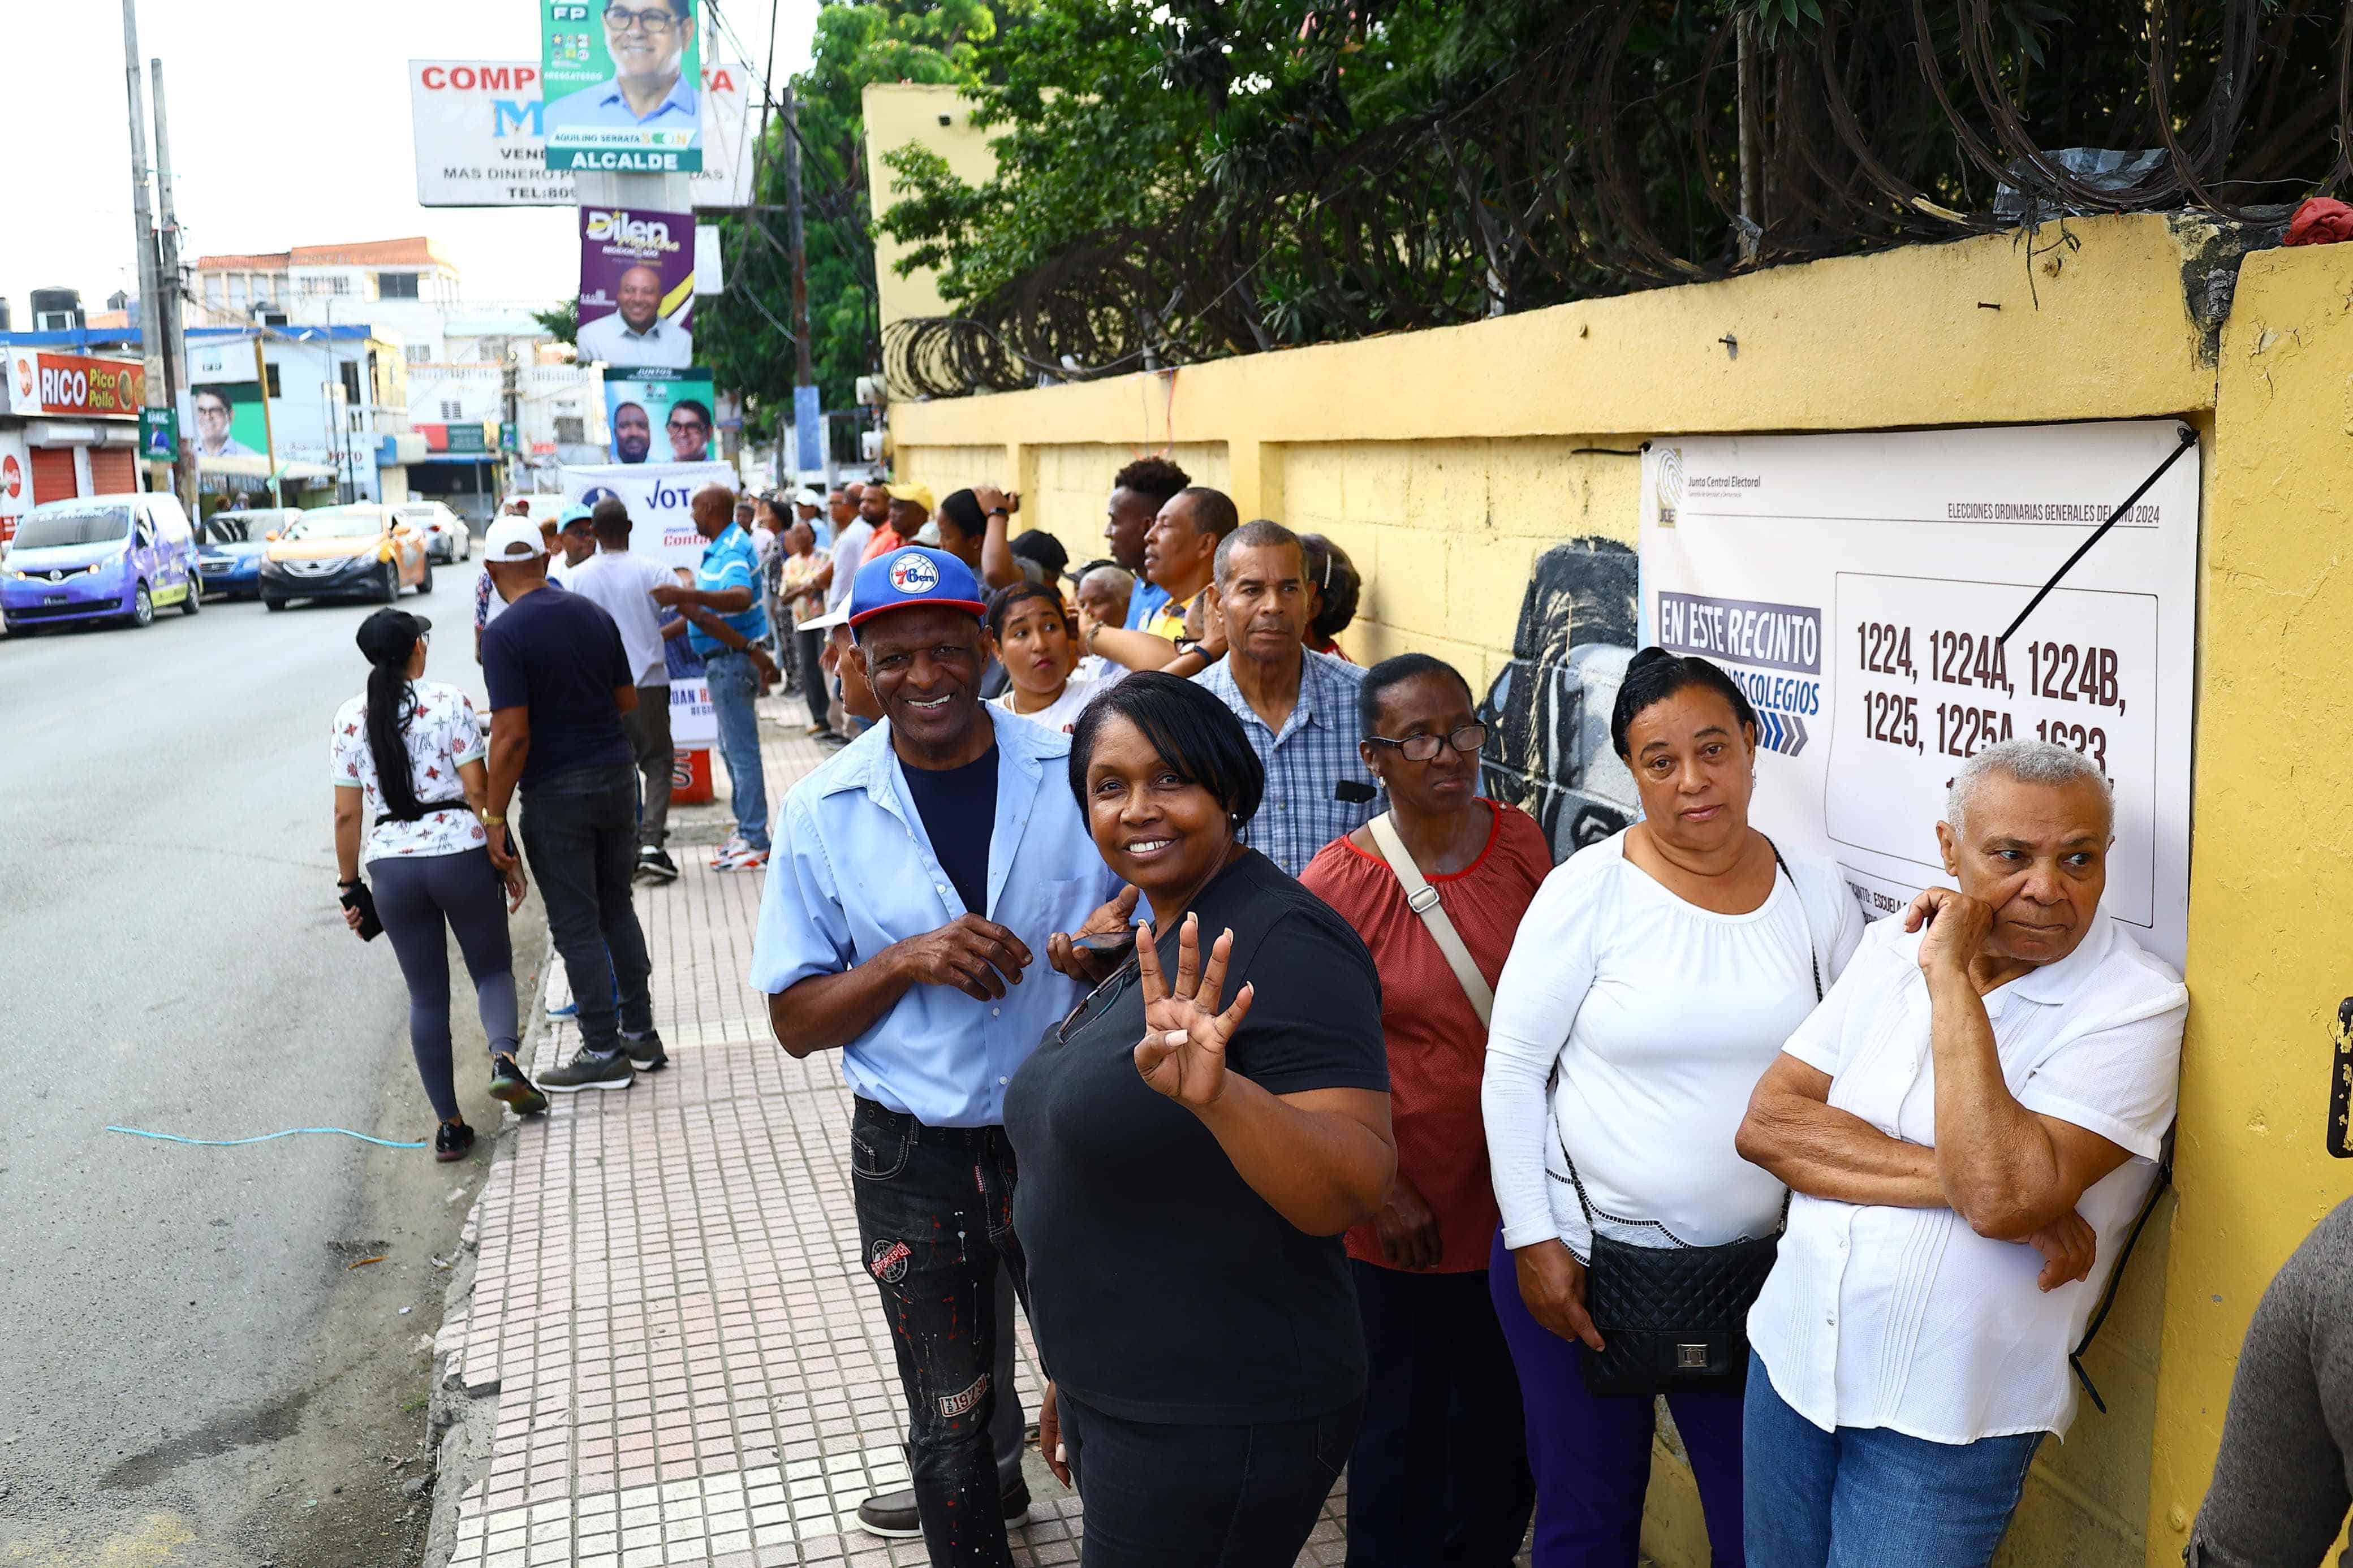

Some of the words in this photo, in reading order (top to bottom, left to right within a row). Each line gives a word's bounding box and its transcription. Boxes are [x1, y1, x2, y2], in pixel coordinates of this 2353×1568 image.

[553, 7, 587, 20] FP
[421, 67, 543, 90] COMP
[570, 151, 678, 170] ALCALDE
[444, 168, 481, 179] MAS
[488, 168, 554, 180] DINERO
[584, 210, 669, 242] Dilen
[41, 367, 87, 407] RICO
[1688, 476, 1706, 487] Junta
[1706, 476, 1730, 487] Central
[1731, 476, 1761, 488] Electoral
[1948, 503, 1993, 519] ELECCIONES
[1994, 504, 2043, 521] ORDINARIAS
[2045, 505, 2095, 521] GENERALES
[2097, 506, 2112, 521] DEL
[2135, 506, 2160, 523] 2024
[895, 568, 935, 585] 76ers
[1662, 599, 1684, 645] EN
[1689, 603, 1725, 653] ESTE
[1727, 608, 1817, 666] RECINTO
[1858, 622, 1917, 684] 1224,
[1930, 630, 2014, 699] 1224A,
[2028, 640, 2126, 716] 1224B,
[1749, 673, 1820, 716] COLEGIOS
[1864, 690, 1924, 756] 1225,
[1873, 891, 1901, 914] ESCUELA
[953, 1379, 984, 1411] 1973
